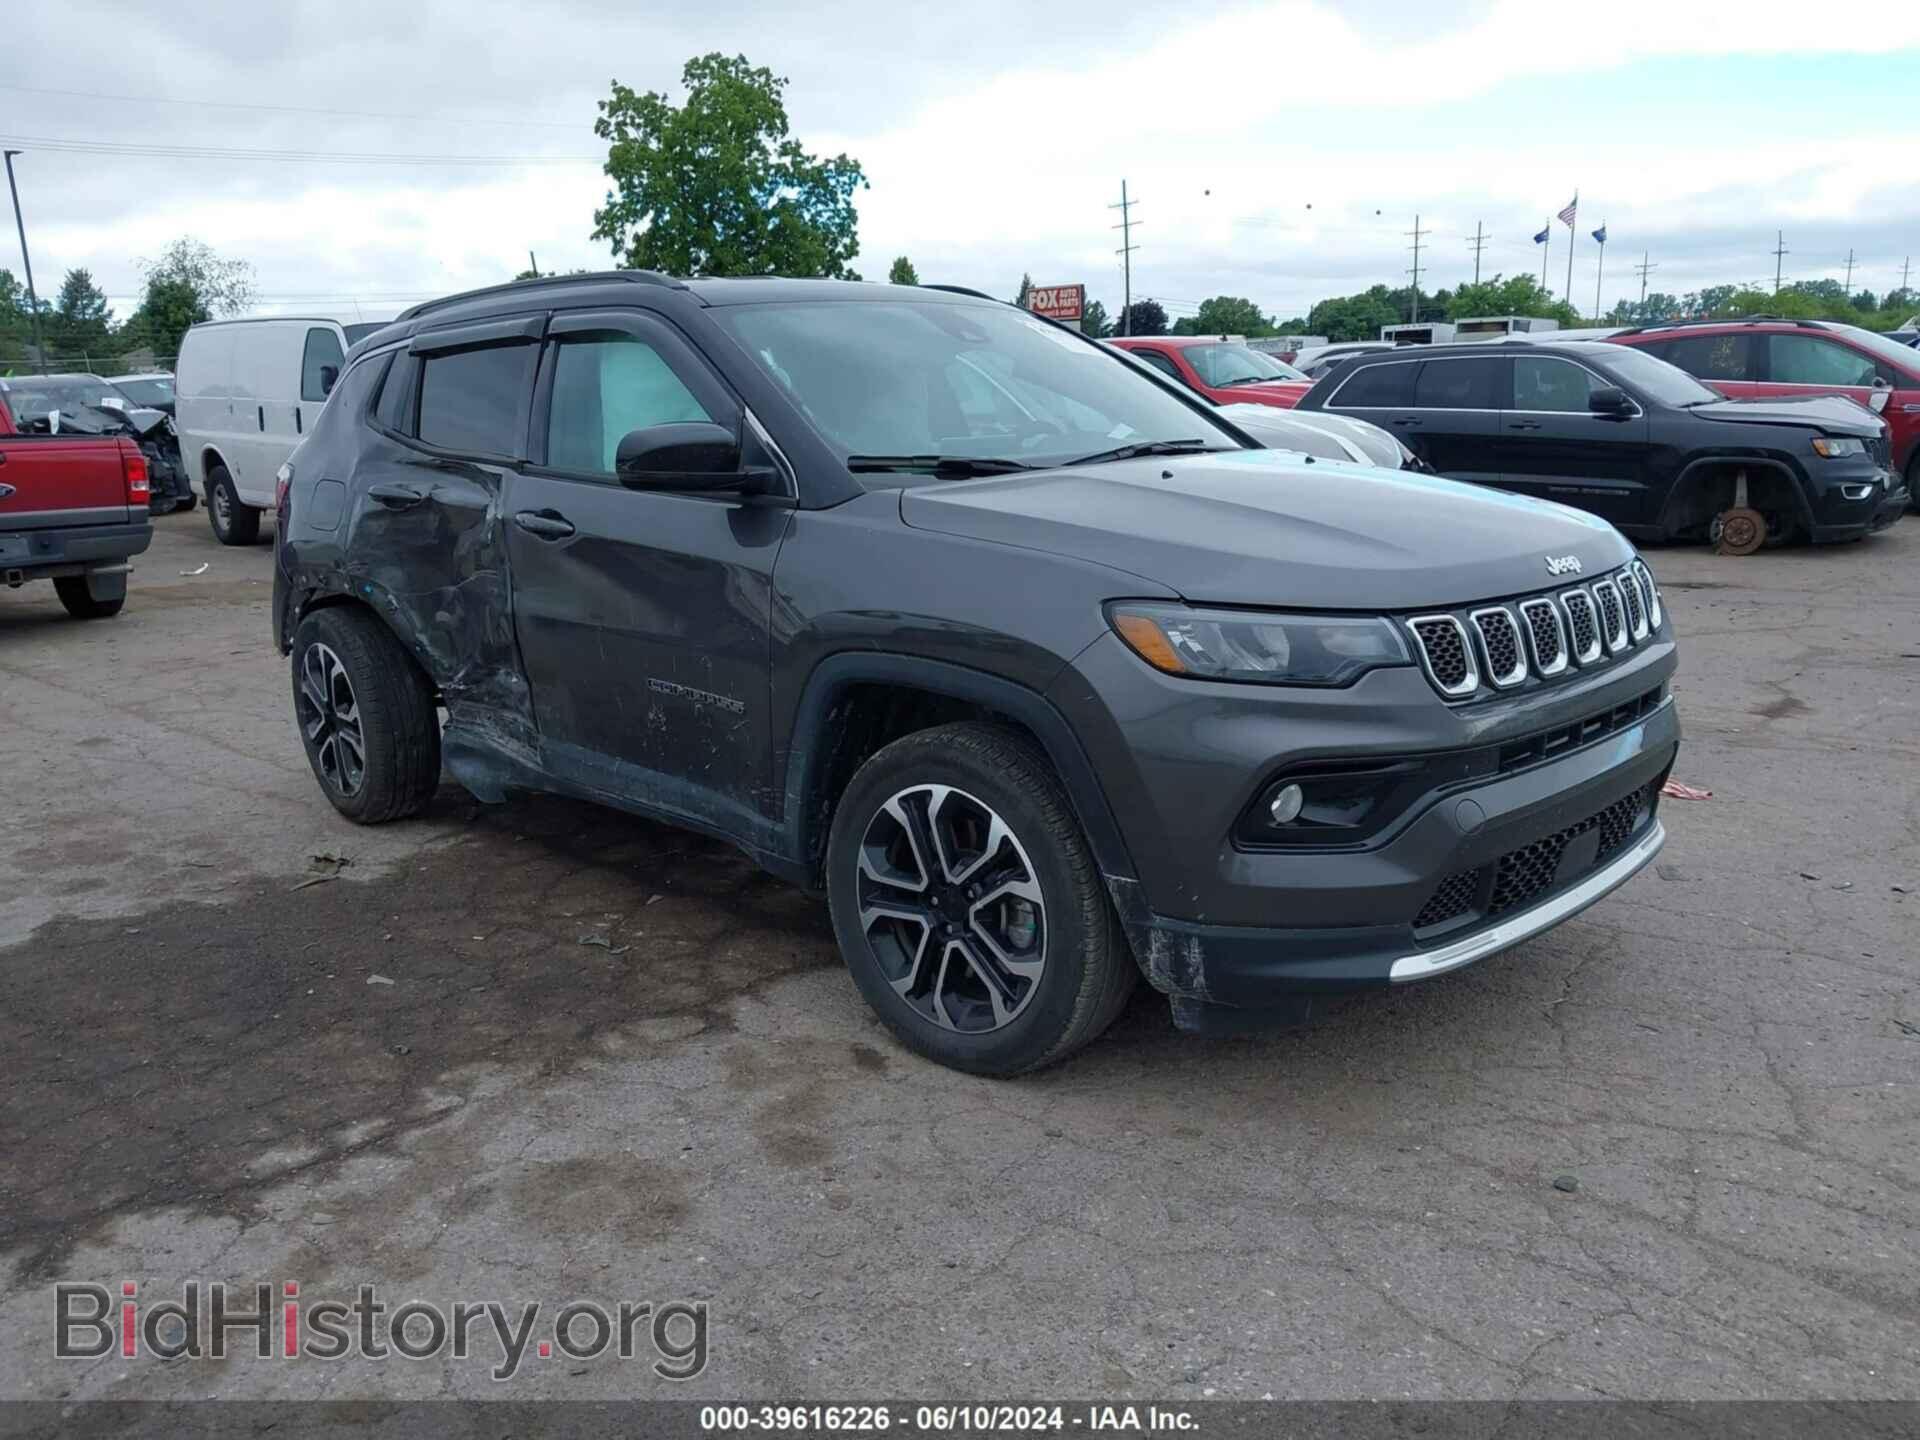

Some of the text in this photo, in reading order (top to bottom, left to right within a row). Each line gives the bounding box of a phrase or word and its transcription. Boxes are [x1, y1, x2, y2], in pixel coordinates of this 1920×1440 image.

[1029, 290, 1059, 310] FOX
[1059, 287, 1077, 298] AUTO
[1059, 297, 1079, 308] PARTS
[1544, 555, 1582, 576] Jeep
